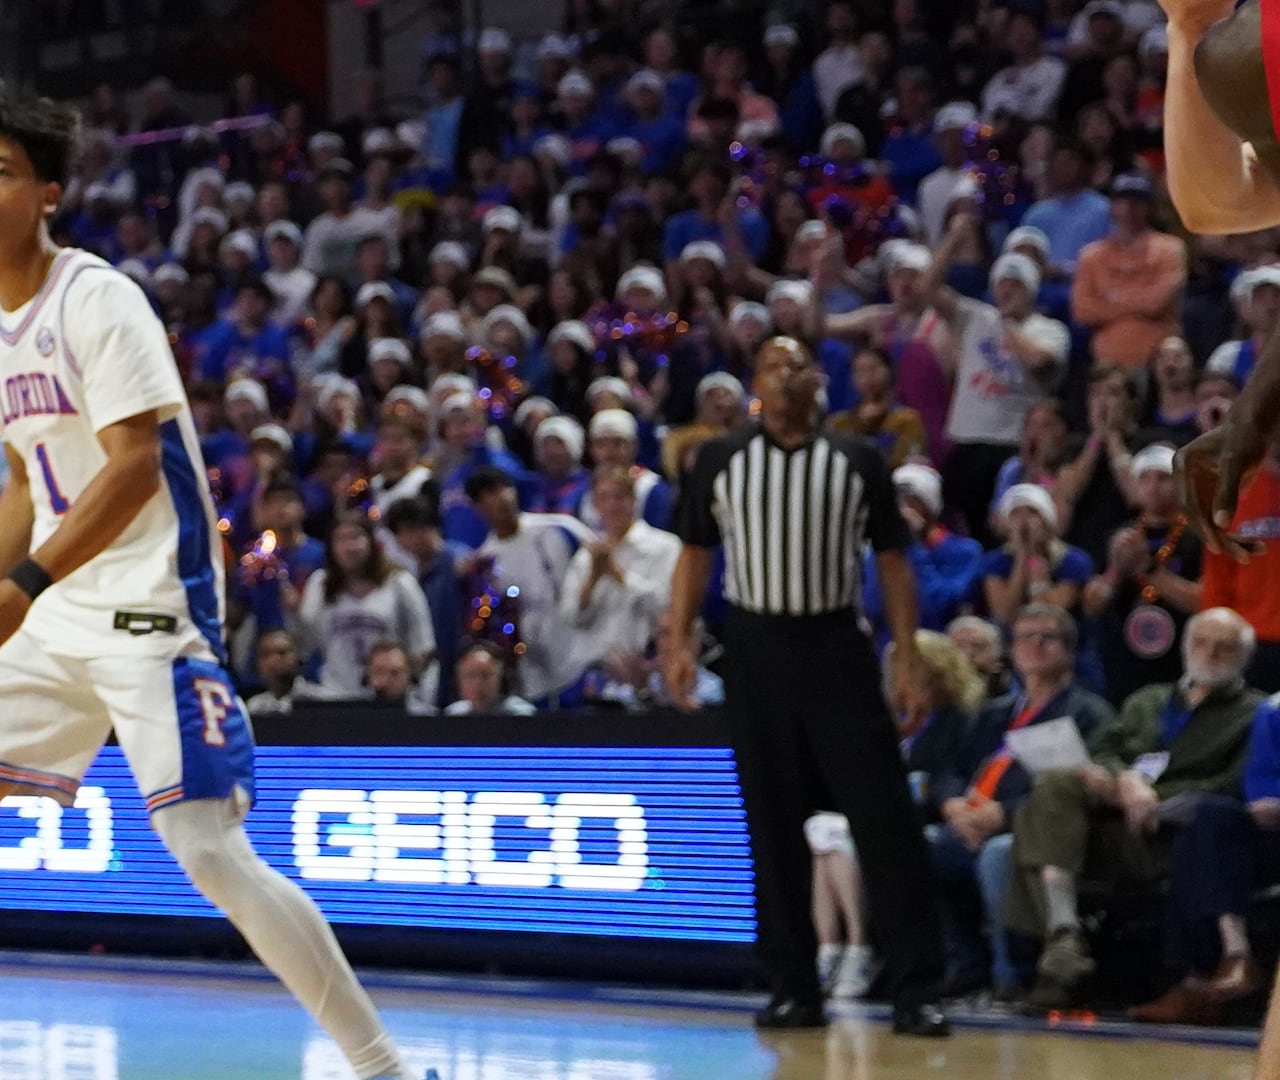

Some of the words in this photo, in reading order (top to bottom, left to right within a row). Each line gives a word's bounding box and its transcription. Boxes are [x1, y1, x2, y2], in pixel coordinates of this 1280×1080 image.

[35, 442, 72, 516] 1
[194, 676, 234, 748] F
[291, 788, 650, 891] GEICO
